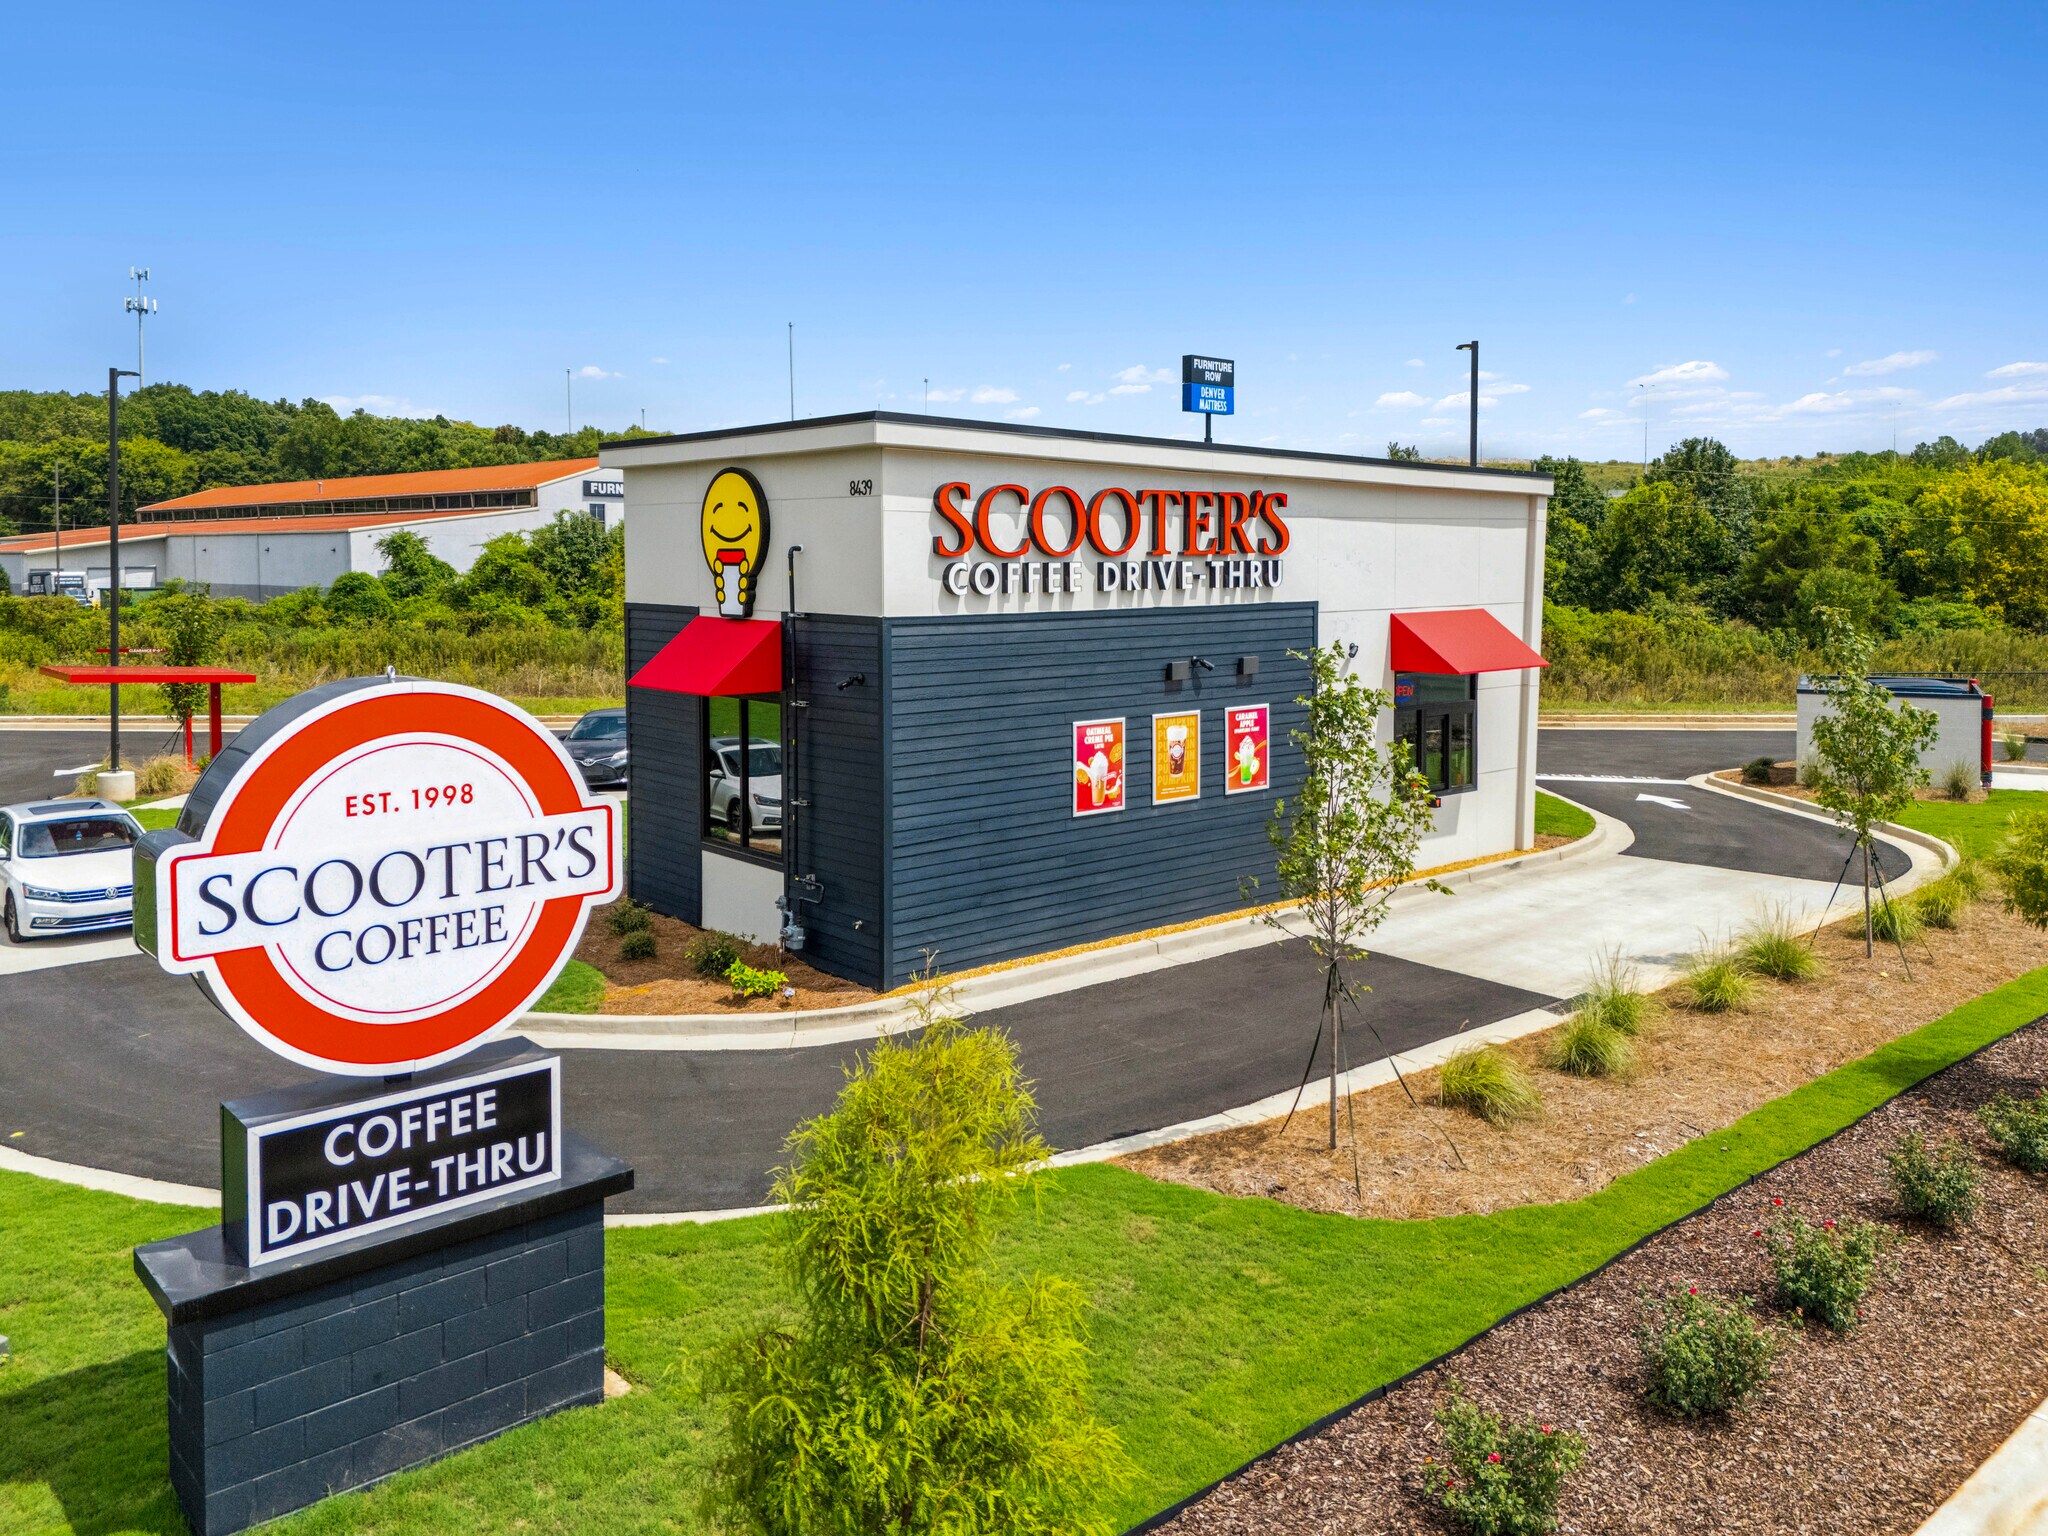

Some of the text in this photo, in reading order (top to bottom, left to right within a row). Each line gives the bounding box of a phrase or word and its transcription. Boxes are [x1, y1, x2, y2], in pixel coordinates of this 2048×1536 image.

[1194, 358, 1233, 373] FURNITURE
[1205, 371, 1222, 382] ROW
[1200, 386, 1225, 399] DENVER
[1199, 399, 1227, 412] MATTRESS
[849, 479, 873, 496] 8439
[933, 481, 1290, 558] SCOOTER'S
[944, 560, 1283, 596] COFFEE DRIVE-THRU
[1235, 711, 1258, 722] CARAMEL
[1240, 719, 1255, 728] APPLE
[1084, 733, 1114, 745] CREME PIE
[1086, 726, 1112, 736] OATMEAL
[345, 783, 474, 818] EST. 1998
[197, 825, 597, 936] SCOOTER'S
[314, 904, 509, 972] COFFEE
[324, 1089, 497, 1167] COFFEE
[268, 1131, 546, 1245] DRIVE-THRU
